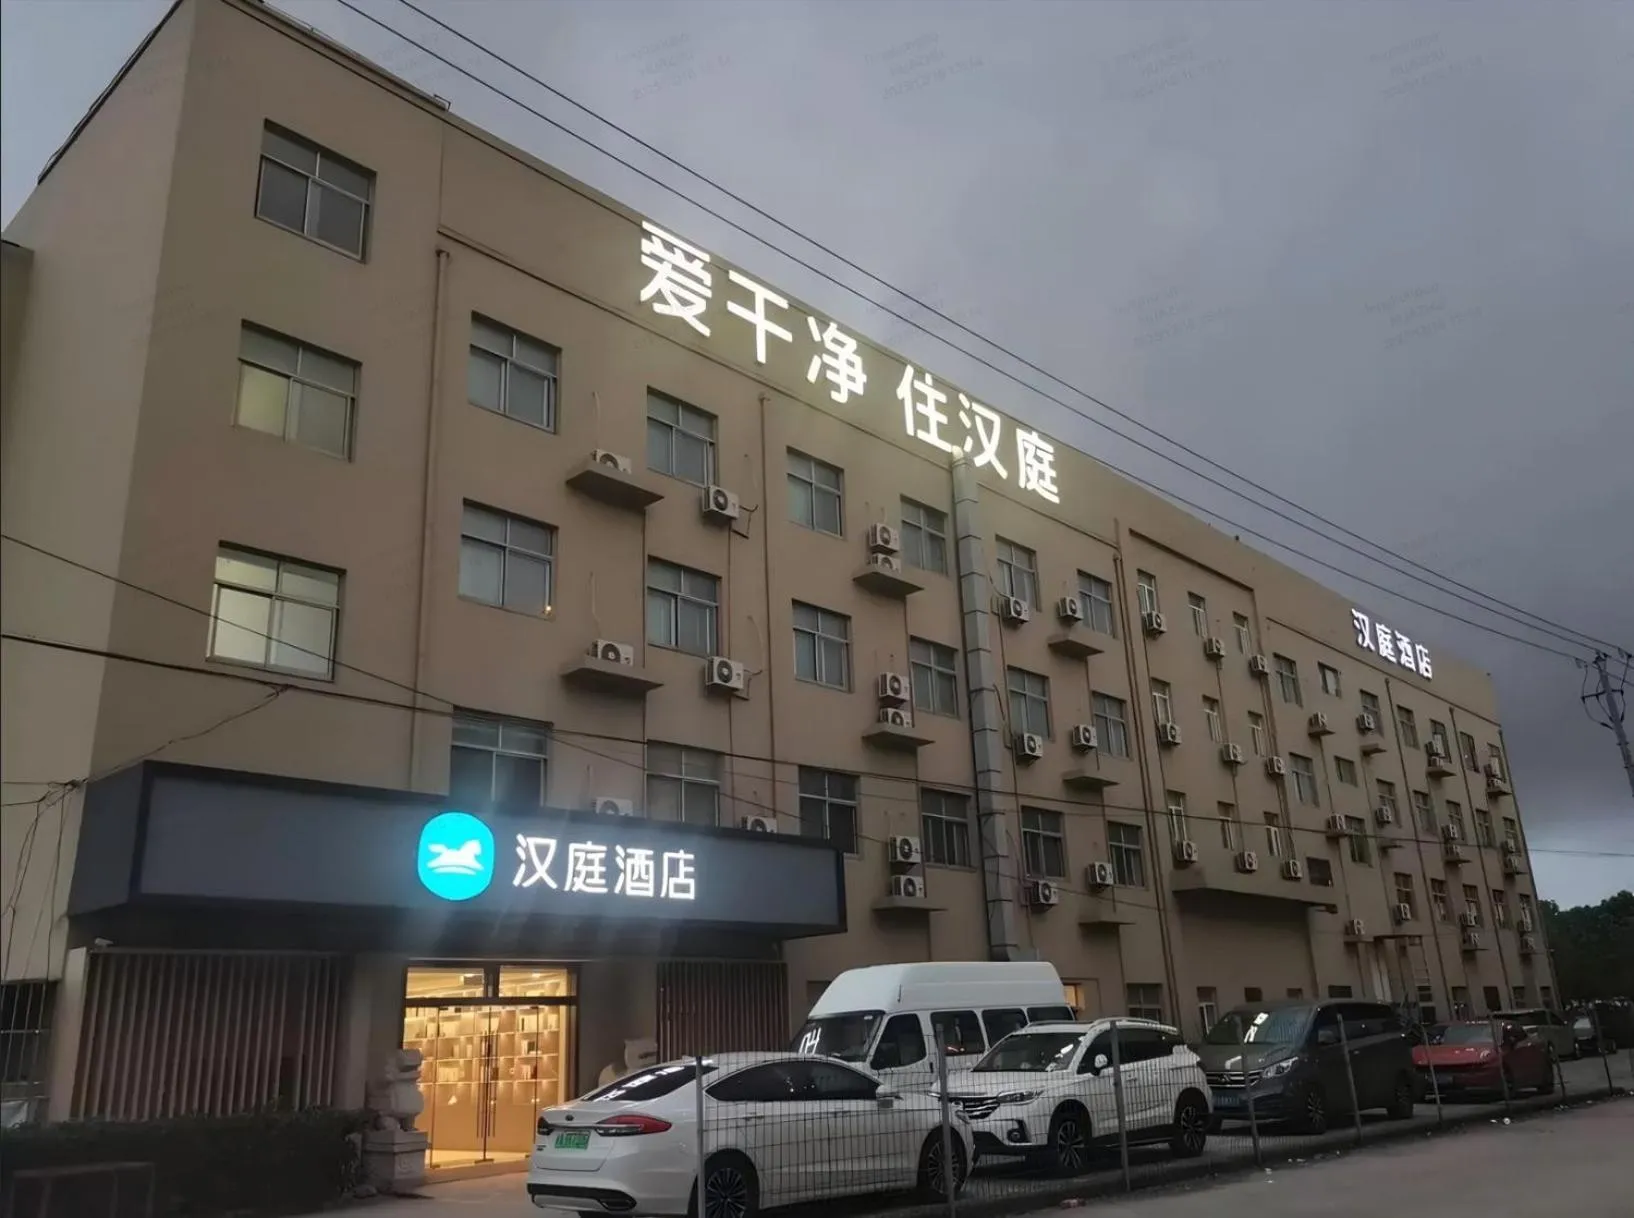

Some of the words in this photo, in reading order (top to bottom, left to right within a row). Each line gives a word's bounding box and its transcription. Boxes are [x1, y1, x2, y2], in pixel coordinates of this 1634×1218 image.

[641, 222, 866, 402] 爱干净
[897, 365, 1059, 503] 住汉庭
[1352, 609, 1432, 677] 汉庭酒店
[513, 834, 694, 899] 汉庭酒店
